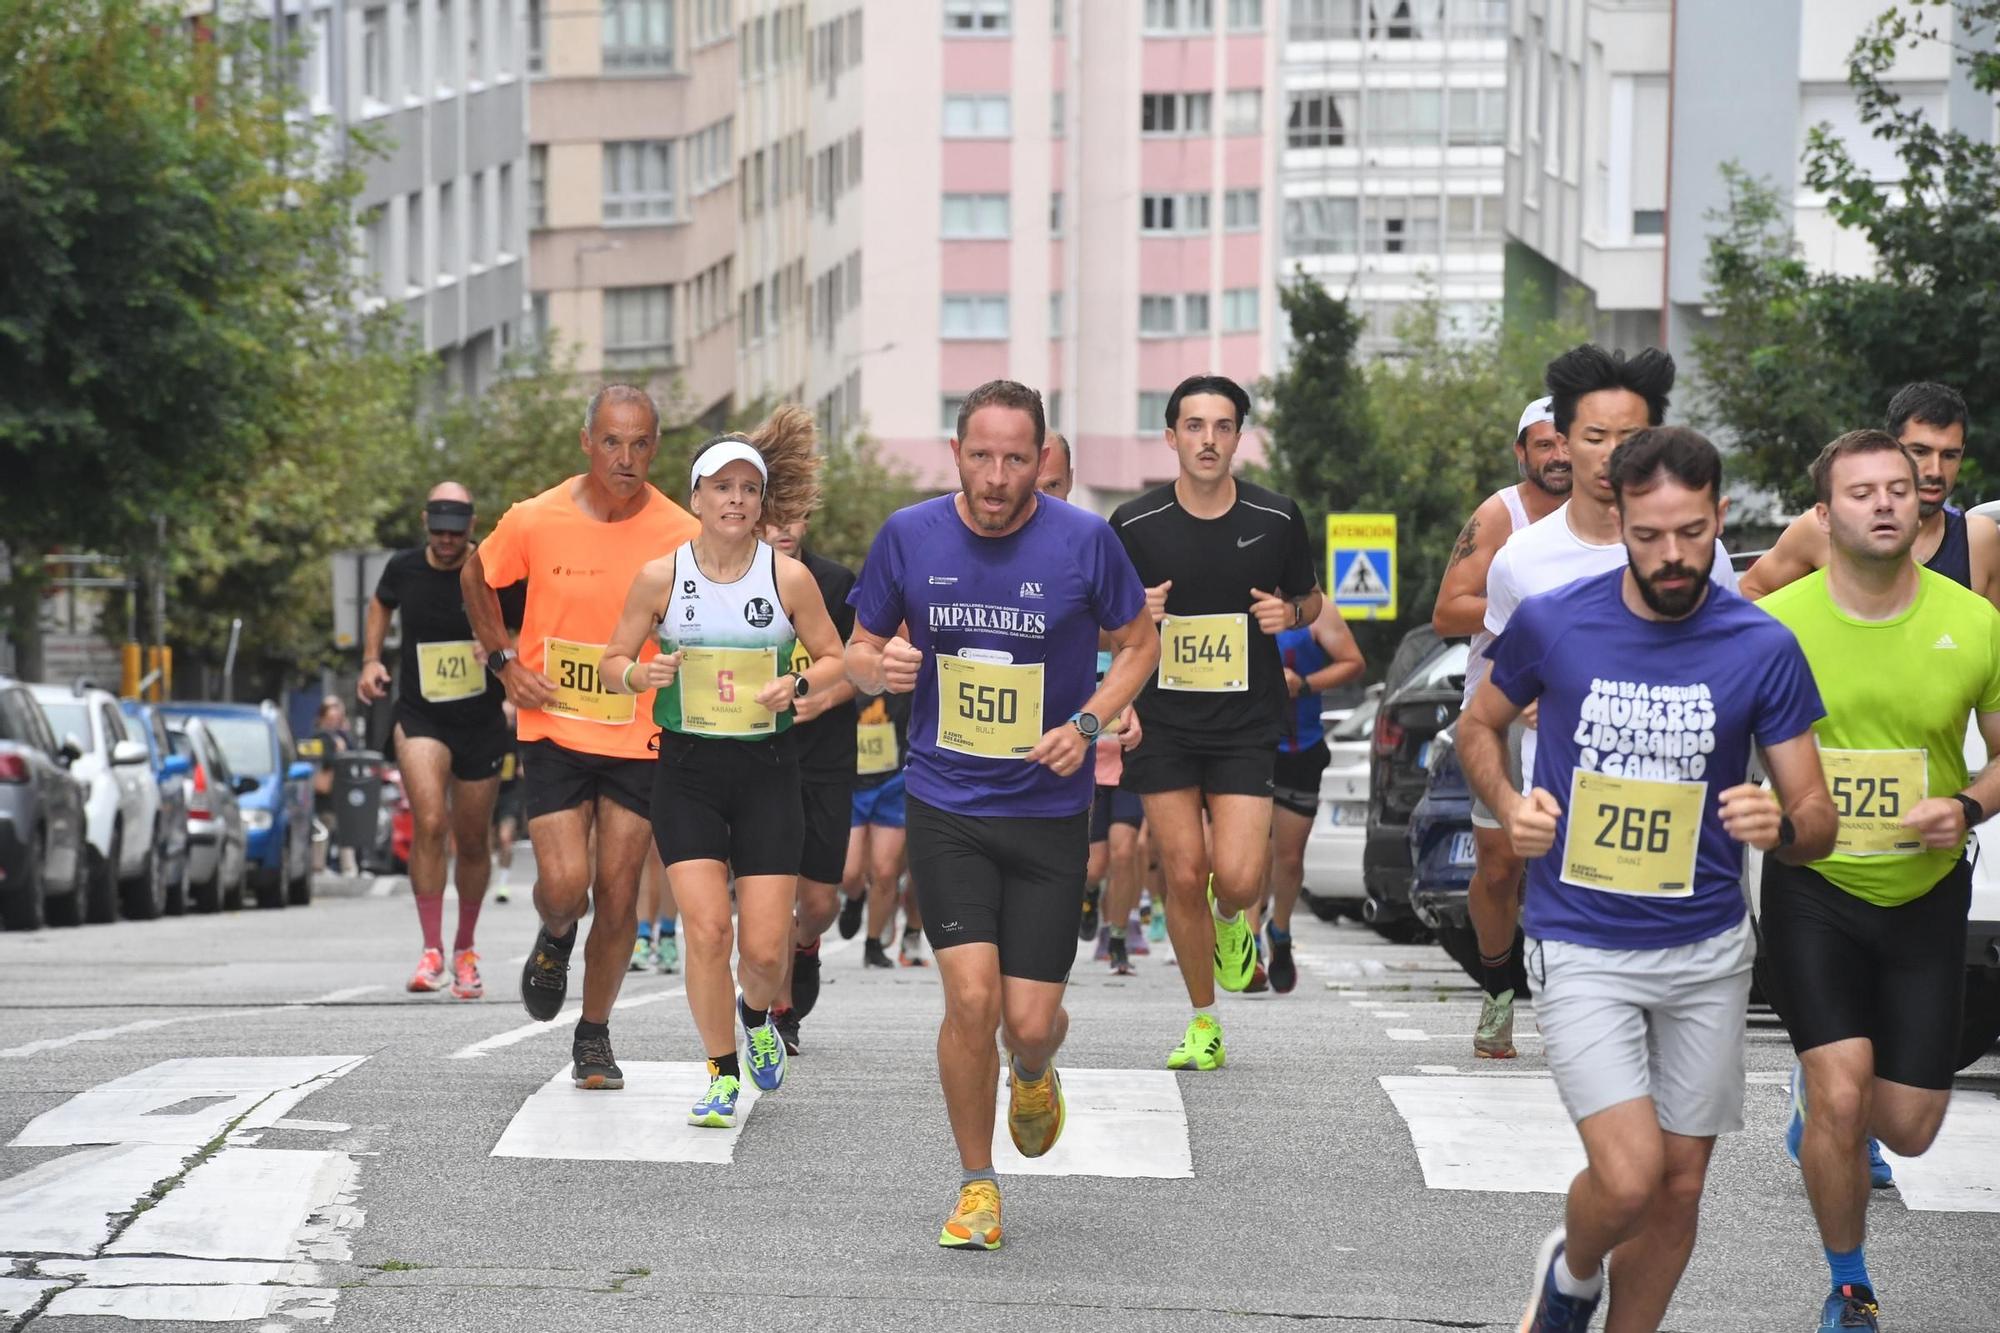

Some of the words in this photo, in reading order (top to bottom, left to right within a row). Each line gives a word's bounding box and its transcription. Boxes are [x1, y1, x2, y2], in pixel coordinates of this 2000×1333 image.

[929, 606, 1046, 634] IMPARABLES
[436, 655, 467, 680] 421
[1173, 634, 1232, 664] 1544
[560, 659, 619, 695] 301
[717, 670, 735, 703] 6
[960, 681, 1018, 724] 550
[1581, 691, 1716, 732] MULLERES
[1573, 719, 1715, 759] LIDERANDO
[1832, 777, 1899, 817] 525
[1594, 803, 1671, 853] 266
